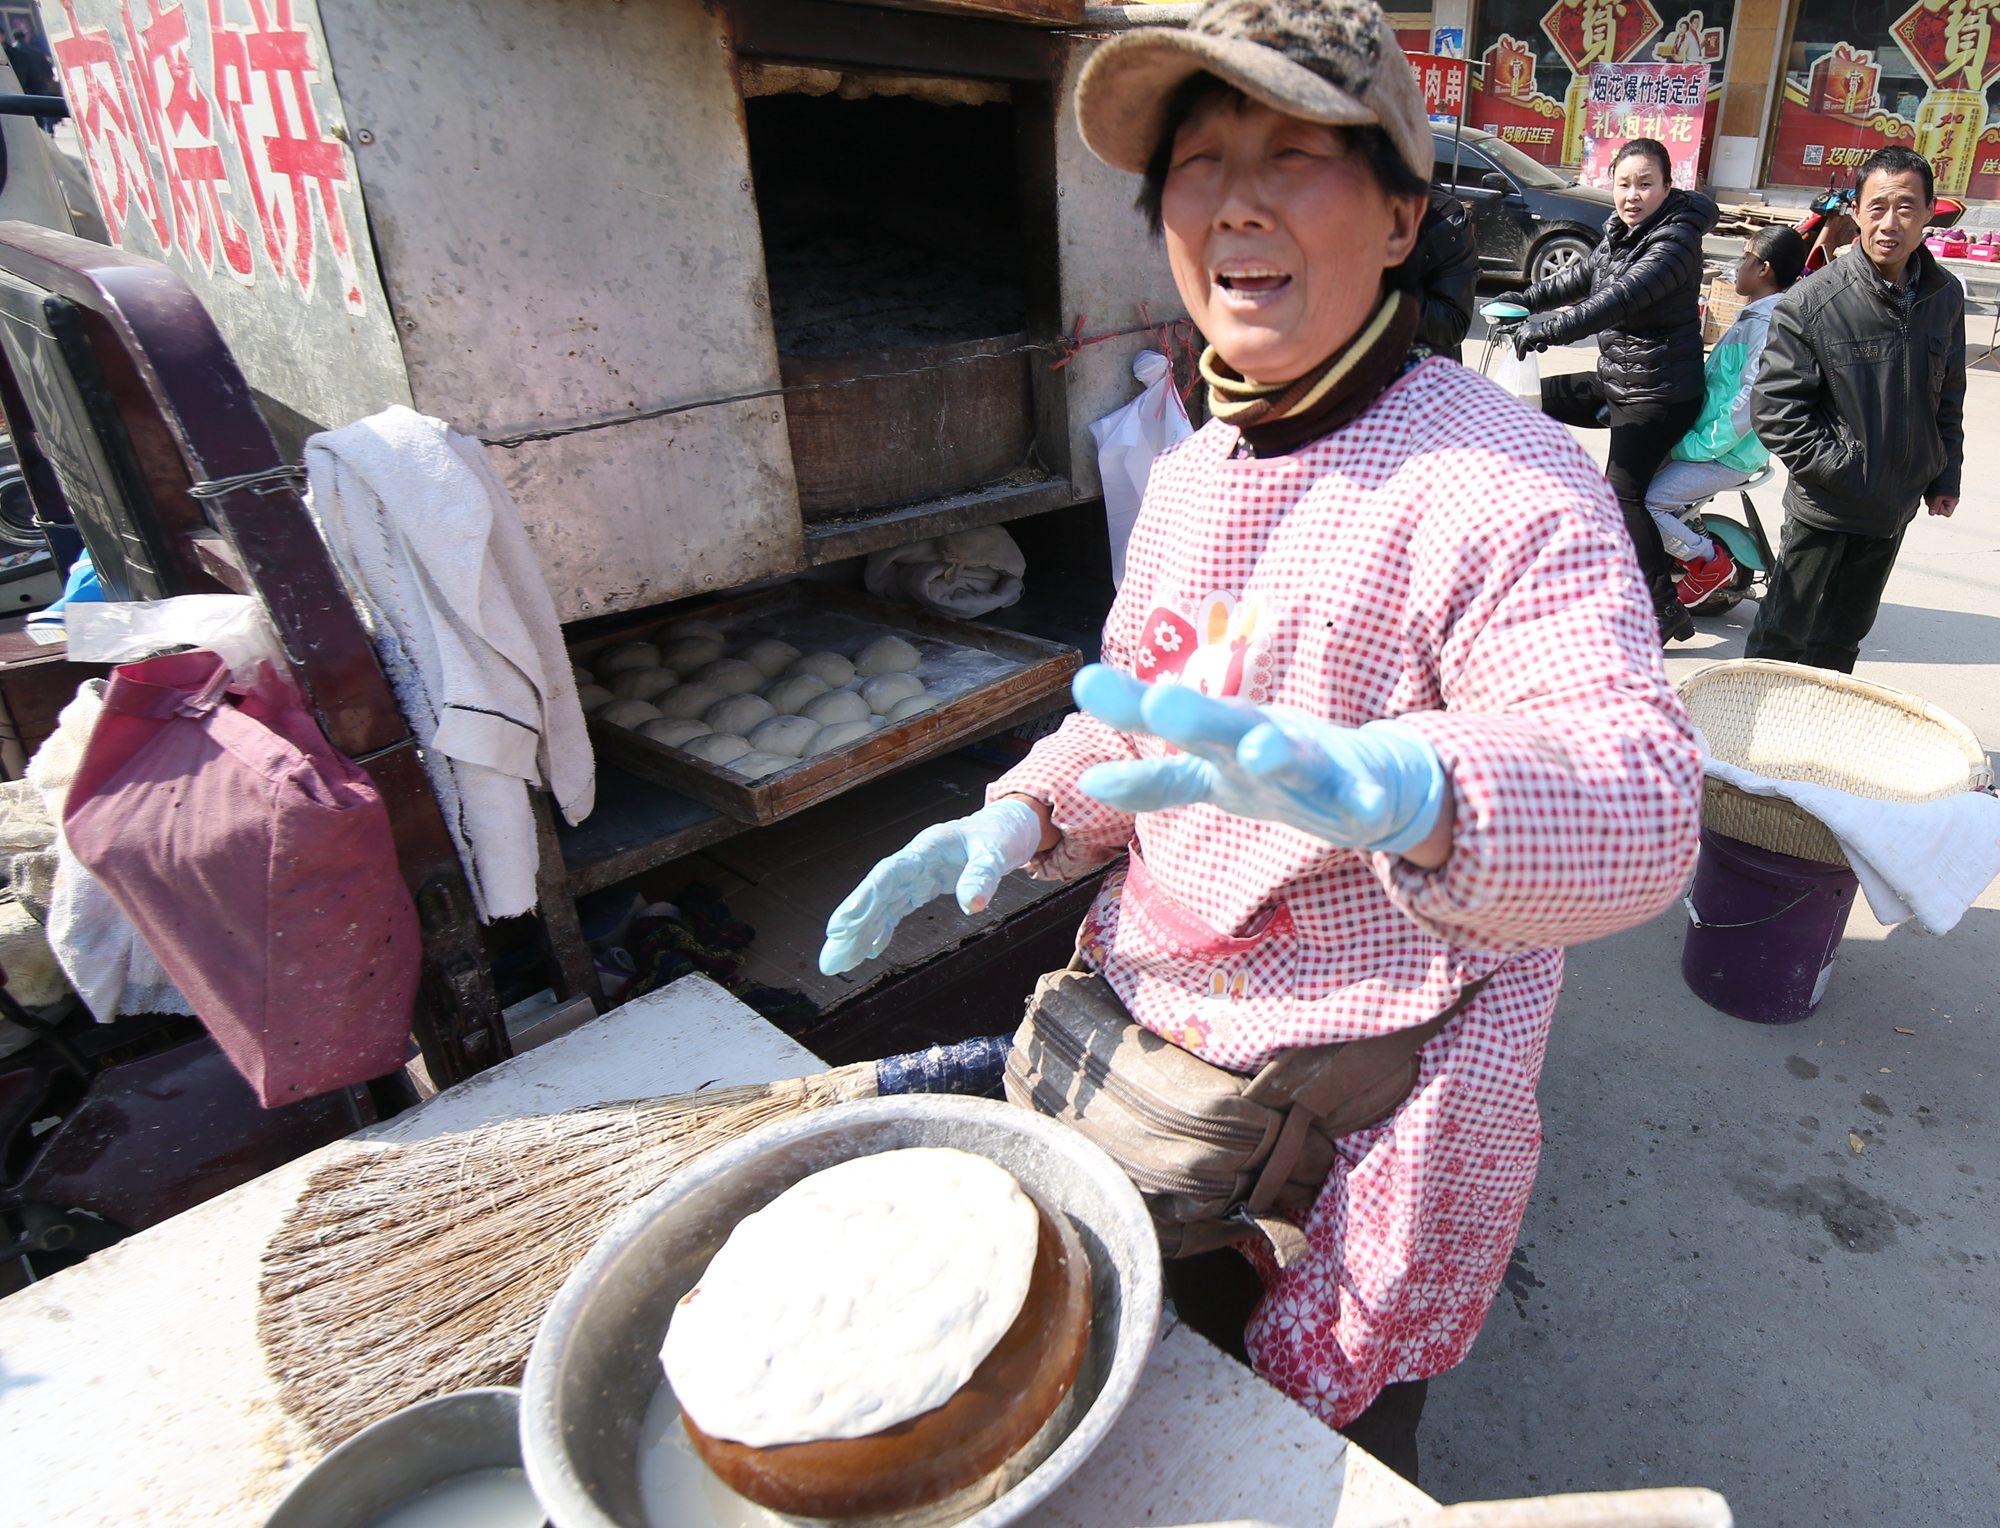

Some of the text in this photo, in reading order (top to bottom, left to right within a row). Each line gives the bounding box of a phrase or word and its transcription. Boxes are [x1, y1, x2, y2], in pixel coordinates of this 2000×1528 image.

[1592, 74, 1702, 105] 烟花爆竹指定点
[1500, 125, 1555, 145] 招财进宝
[1591, 110, 1695, 143] 礼炮礼花
